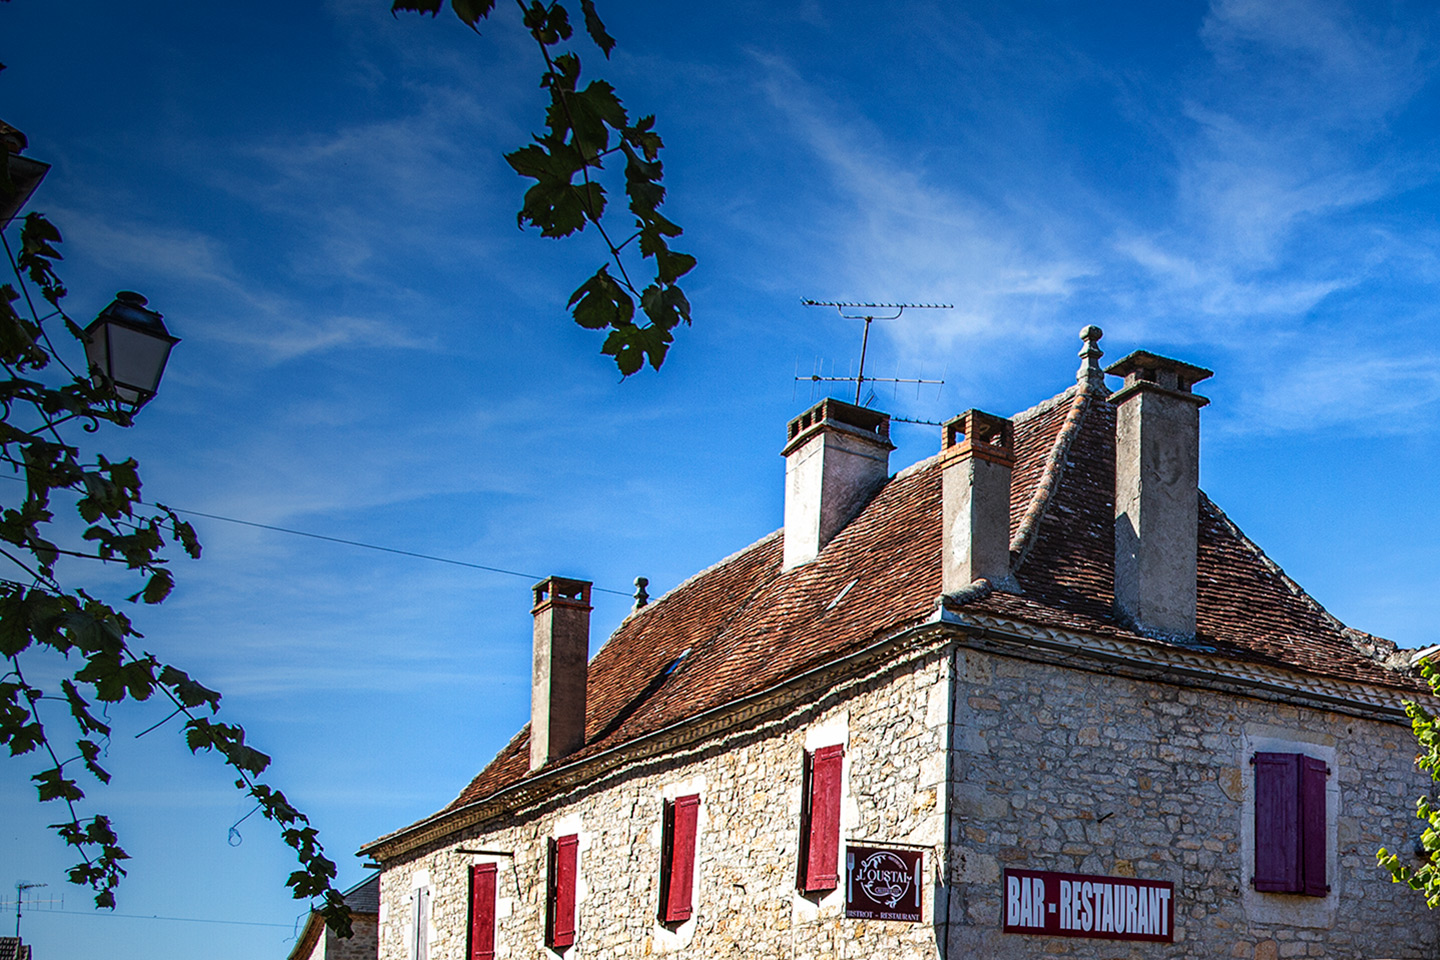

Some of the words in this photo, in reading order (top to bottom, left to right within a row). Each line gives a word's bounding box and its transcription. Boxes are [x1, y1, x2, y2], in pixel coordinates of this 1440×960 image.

[847, 910, 873, 918] BISTROT
[880, 912, 919, 921] RESTAURANT
[1007, 875, 1045, 928] BAR
[1060, 880, 1171, 936] RESTAURANT
